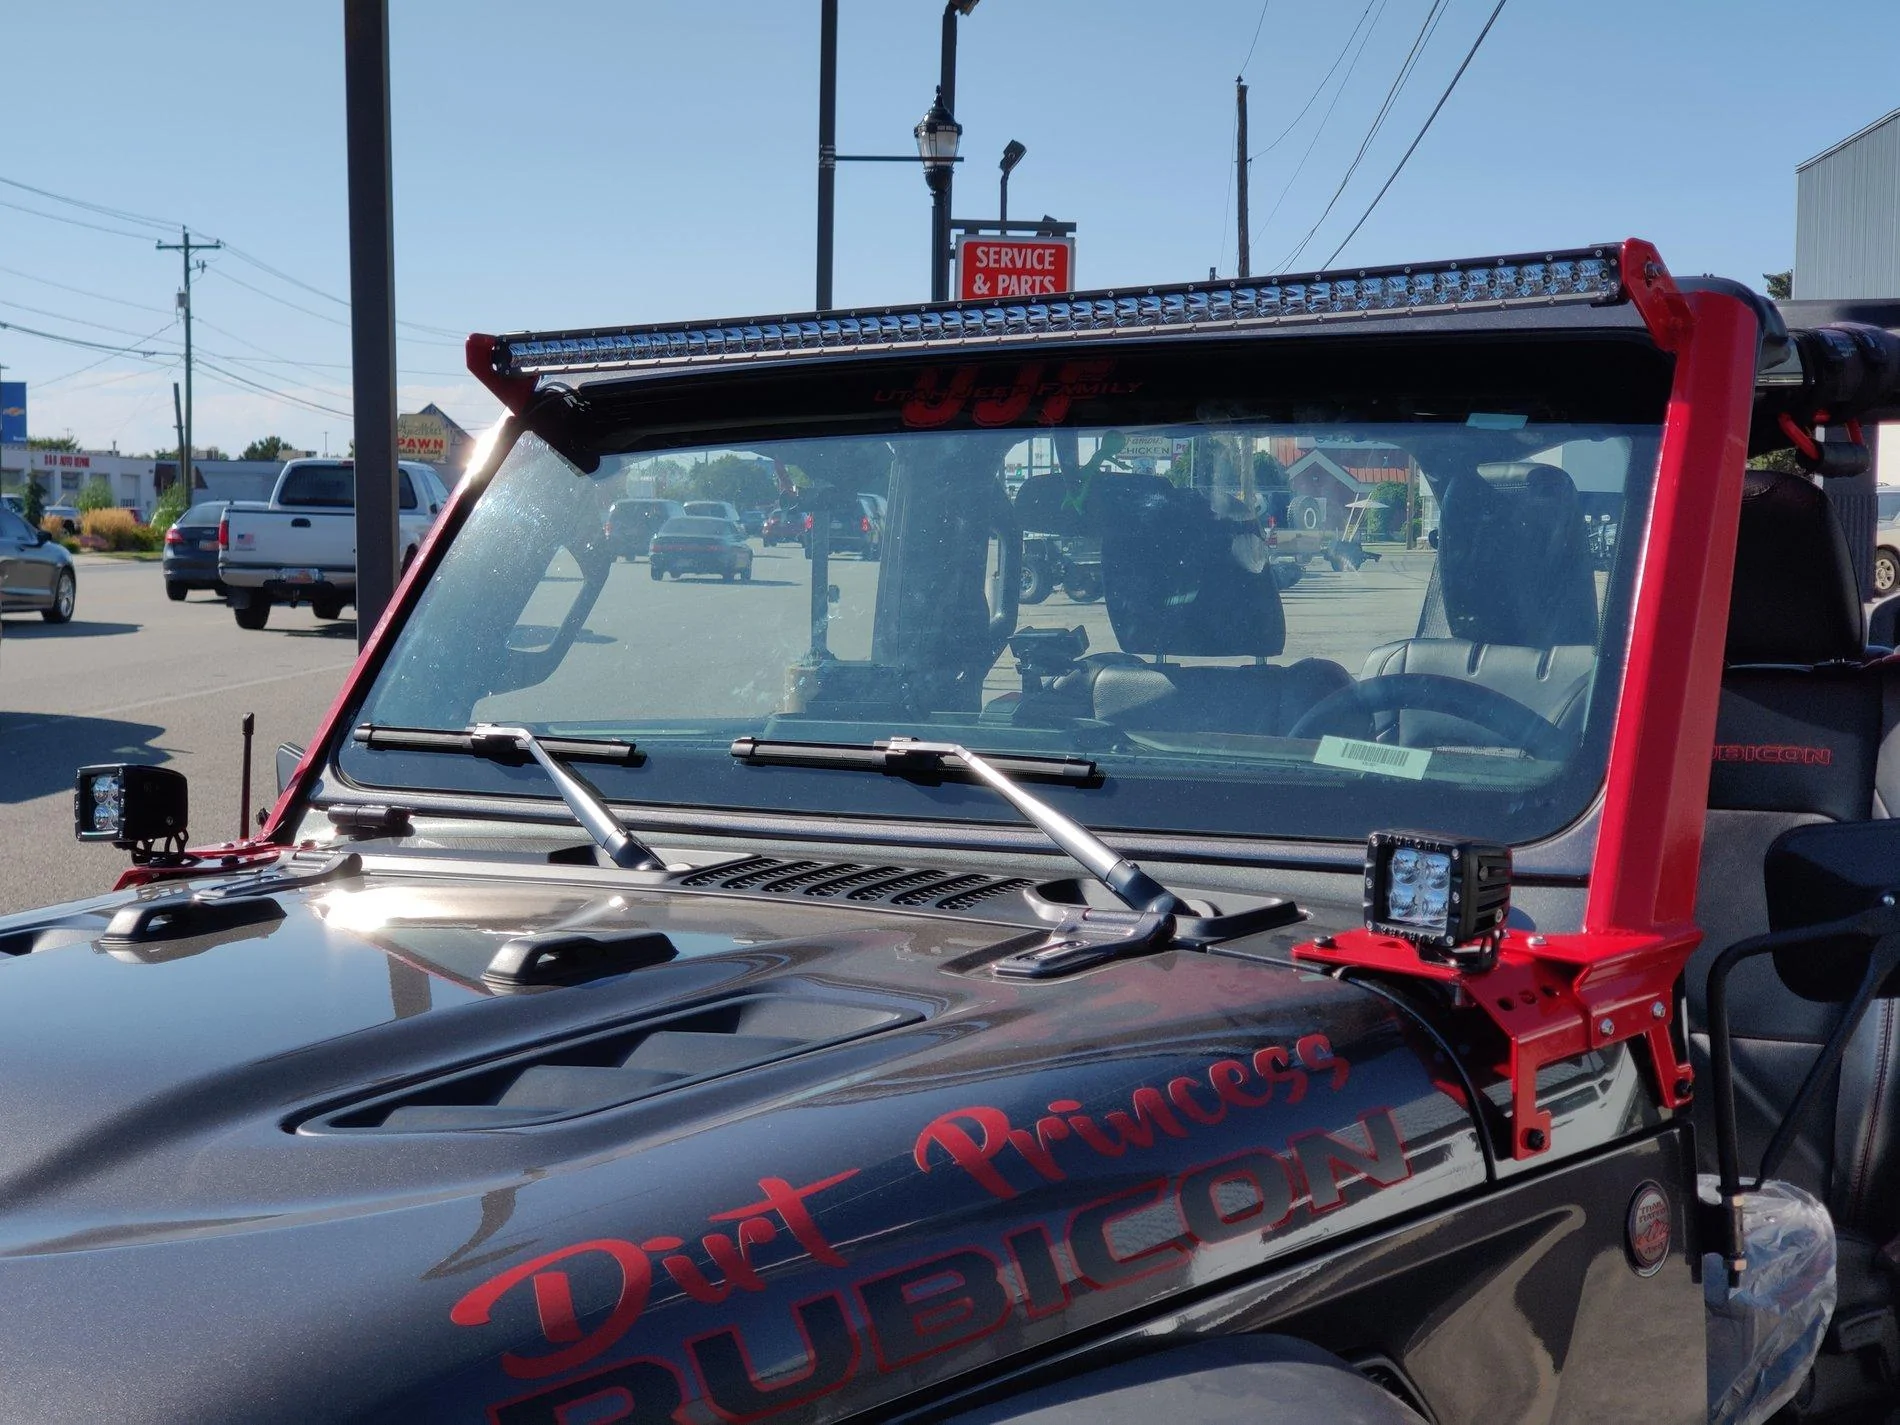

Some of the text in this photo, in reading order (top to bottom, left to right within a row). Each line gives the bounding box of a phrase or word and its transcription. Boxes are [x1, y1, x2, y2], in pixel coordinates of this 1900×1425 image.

[976, 247, 1056, 270] SERVICE
[973, 273, 1056, 296] & PARTS
[1037, 380, 1143, 396] FAMILY
[397, 438, 444, 449] PAWN
[1118, 447, 1170, 455] CHICKEN
[450, 1033, 1351, 1380] Dirt Princess
[484, 1105, 1414, 1425] RUBICON
